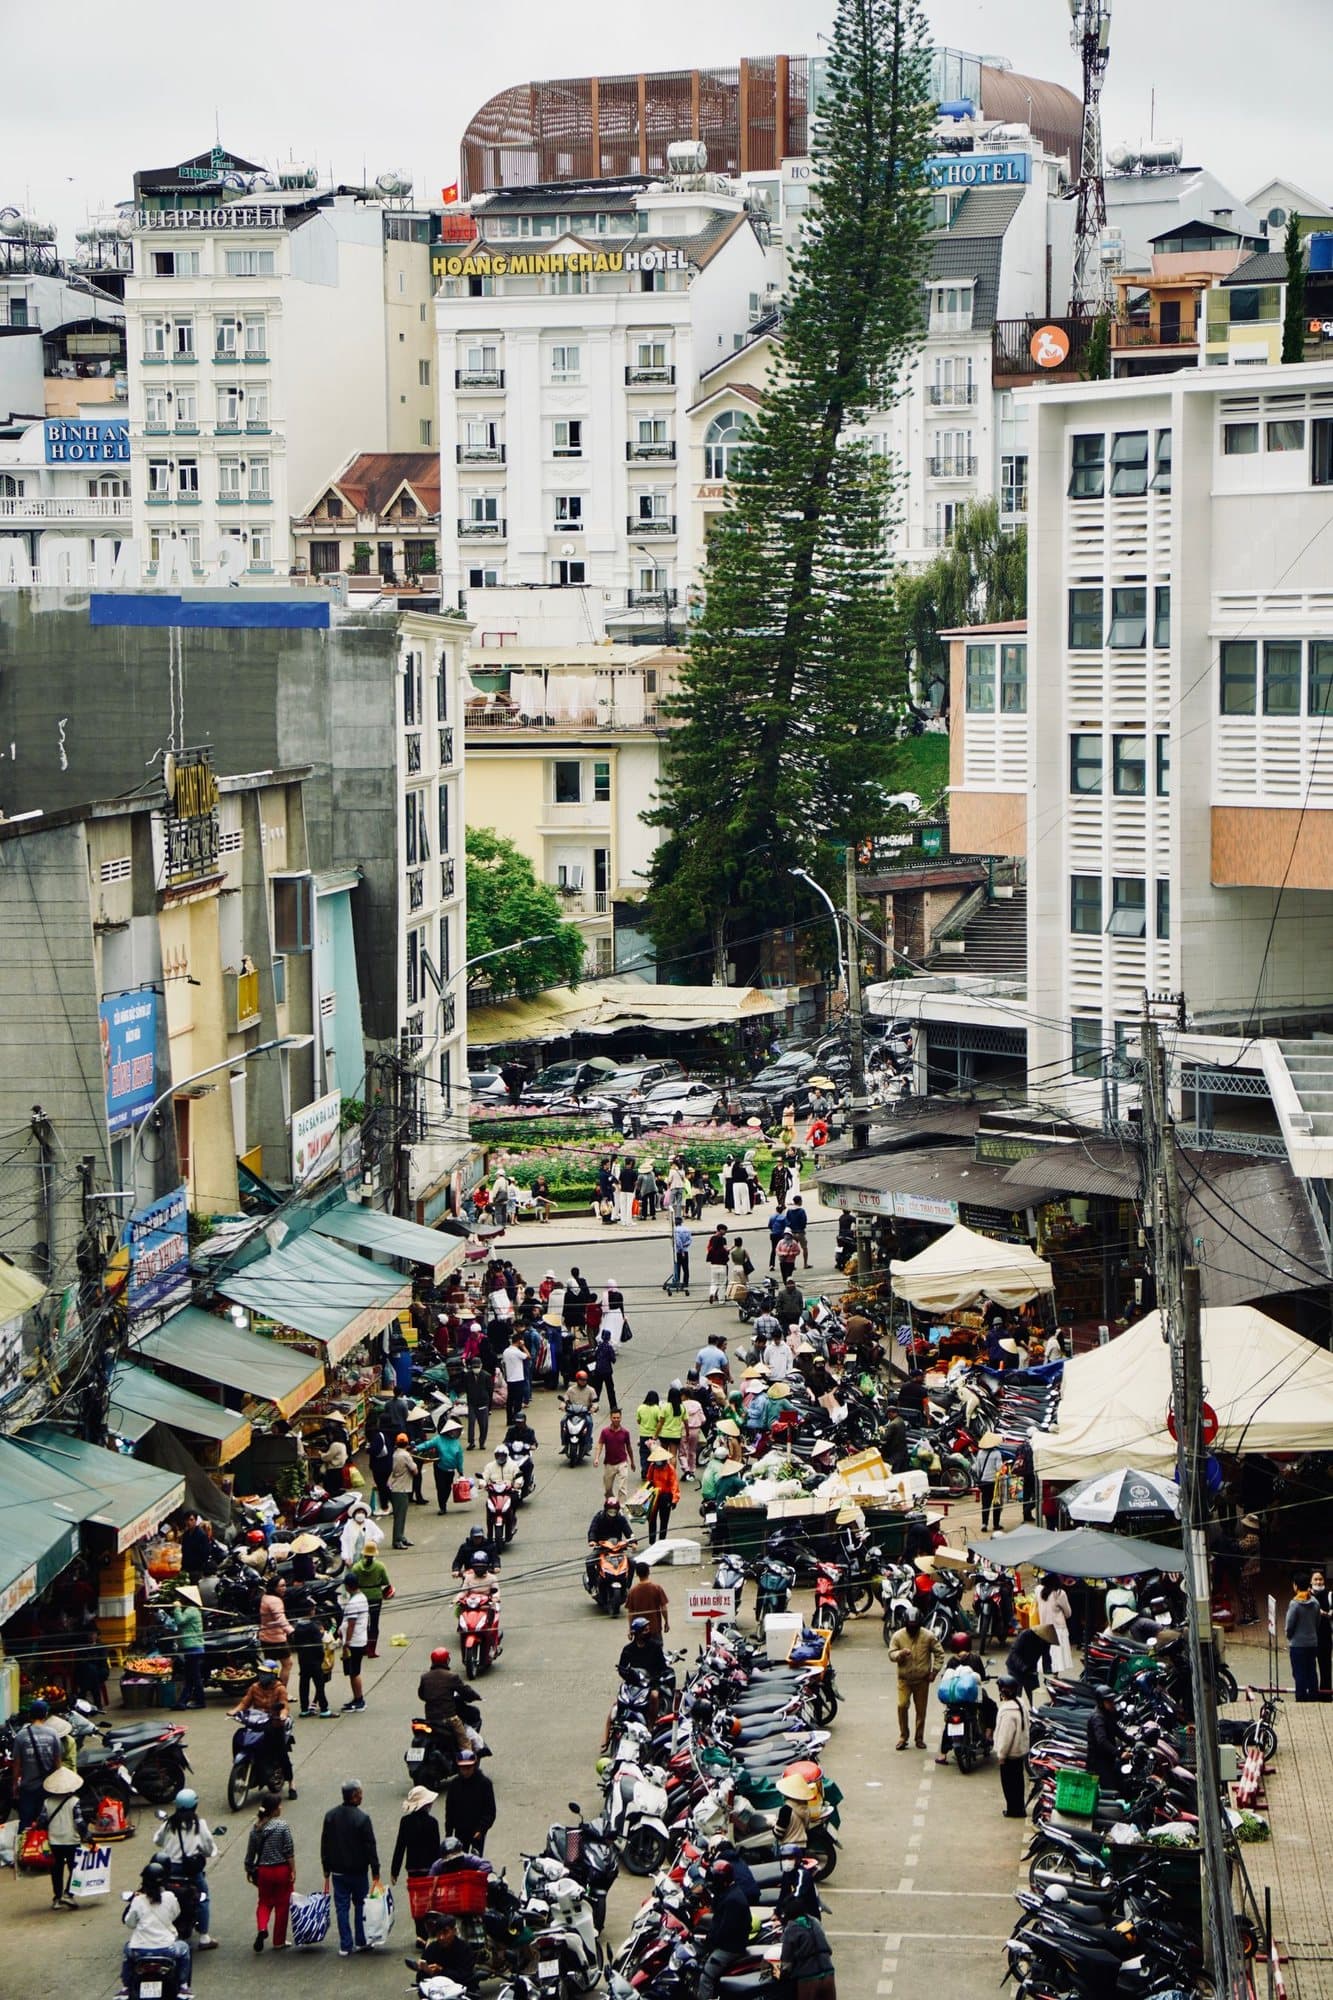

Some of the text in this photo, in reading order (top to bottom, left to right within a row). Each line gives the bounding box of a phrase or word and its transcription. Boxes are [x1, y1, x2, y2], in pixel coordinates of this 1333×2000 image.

[948, 161, 1020, 183] HOTEL
[199, 207, 265, 227] HOTEL
[432, 250, 690, 276] HOANG MINH CHAU HOTEL
[48, 422, 98, 441] BÌNH
[51, 444, 130, 459] HOTEL
